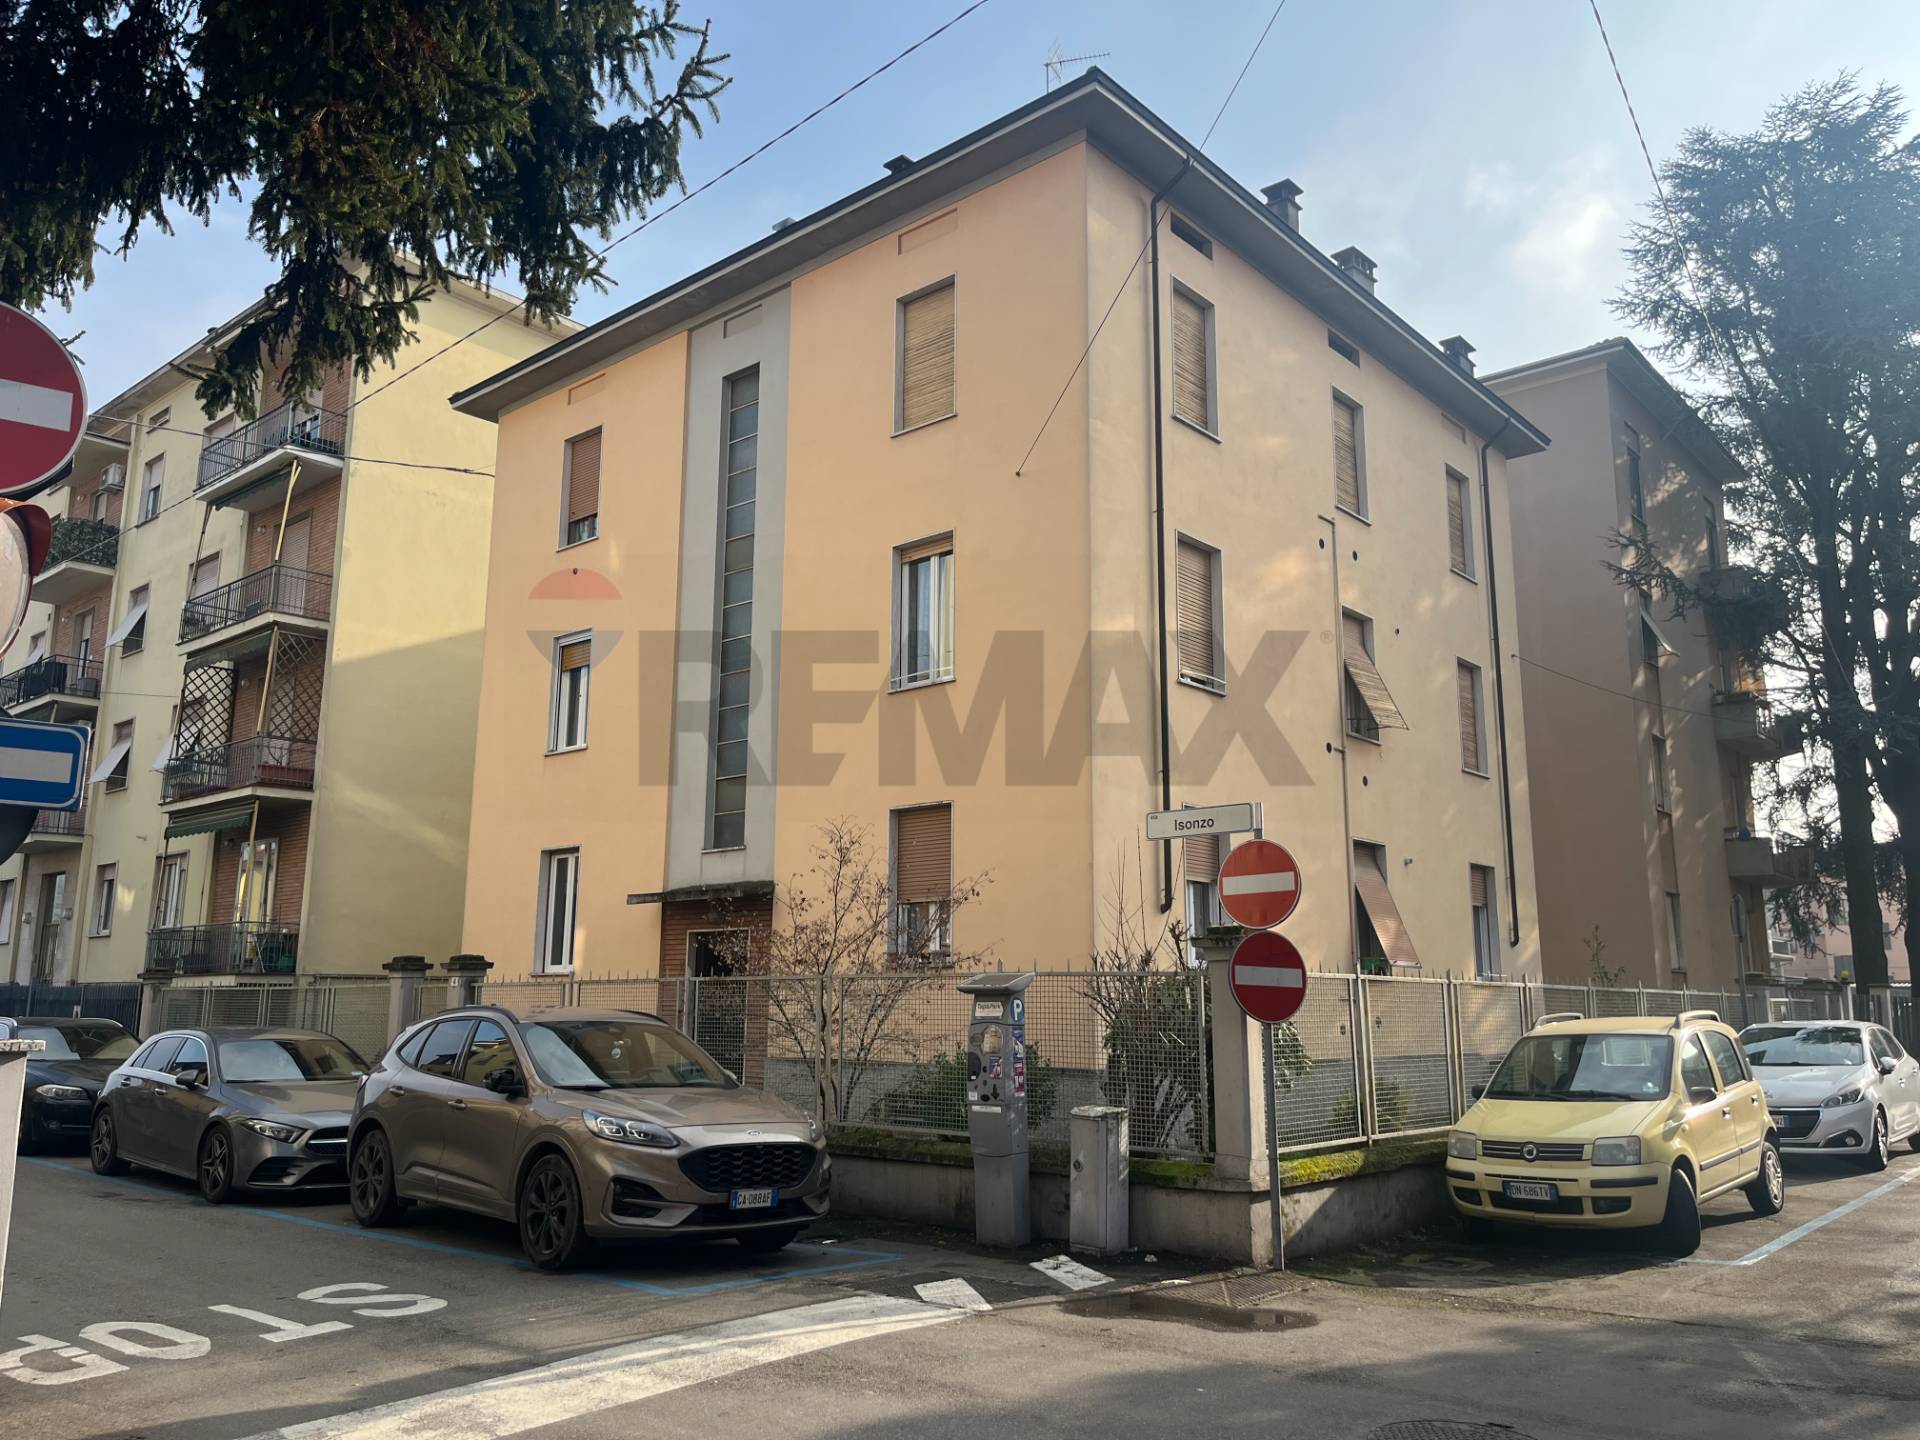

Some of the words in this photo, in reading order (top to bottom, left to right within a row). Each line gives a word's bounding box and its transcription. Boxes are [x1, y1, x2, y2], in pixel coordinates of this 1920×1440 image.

[1174, 818, 1215, 832] Isonzo
[1013, 999, 1023, 1021] P
[0, 1282, 448, 1386] STOP
